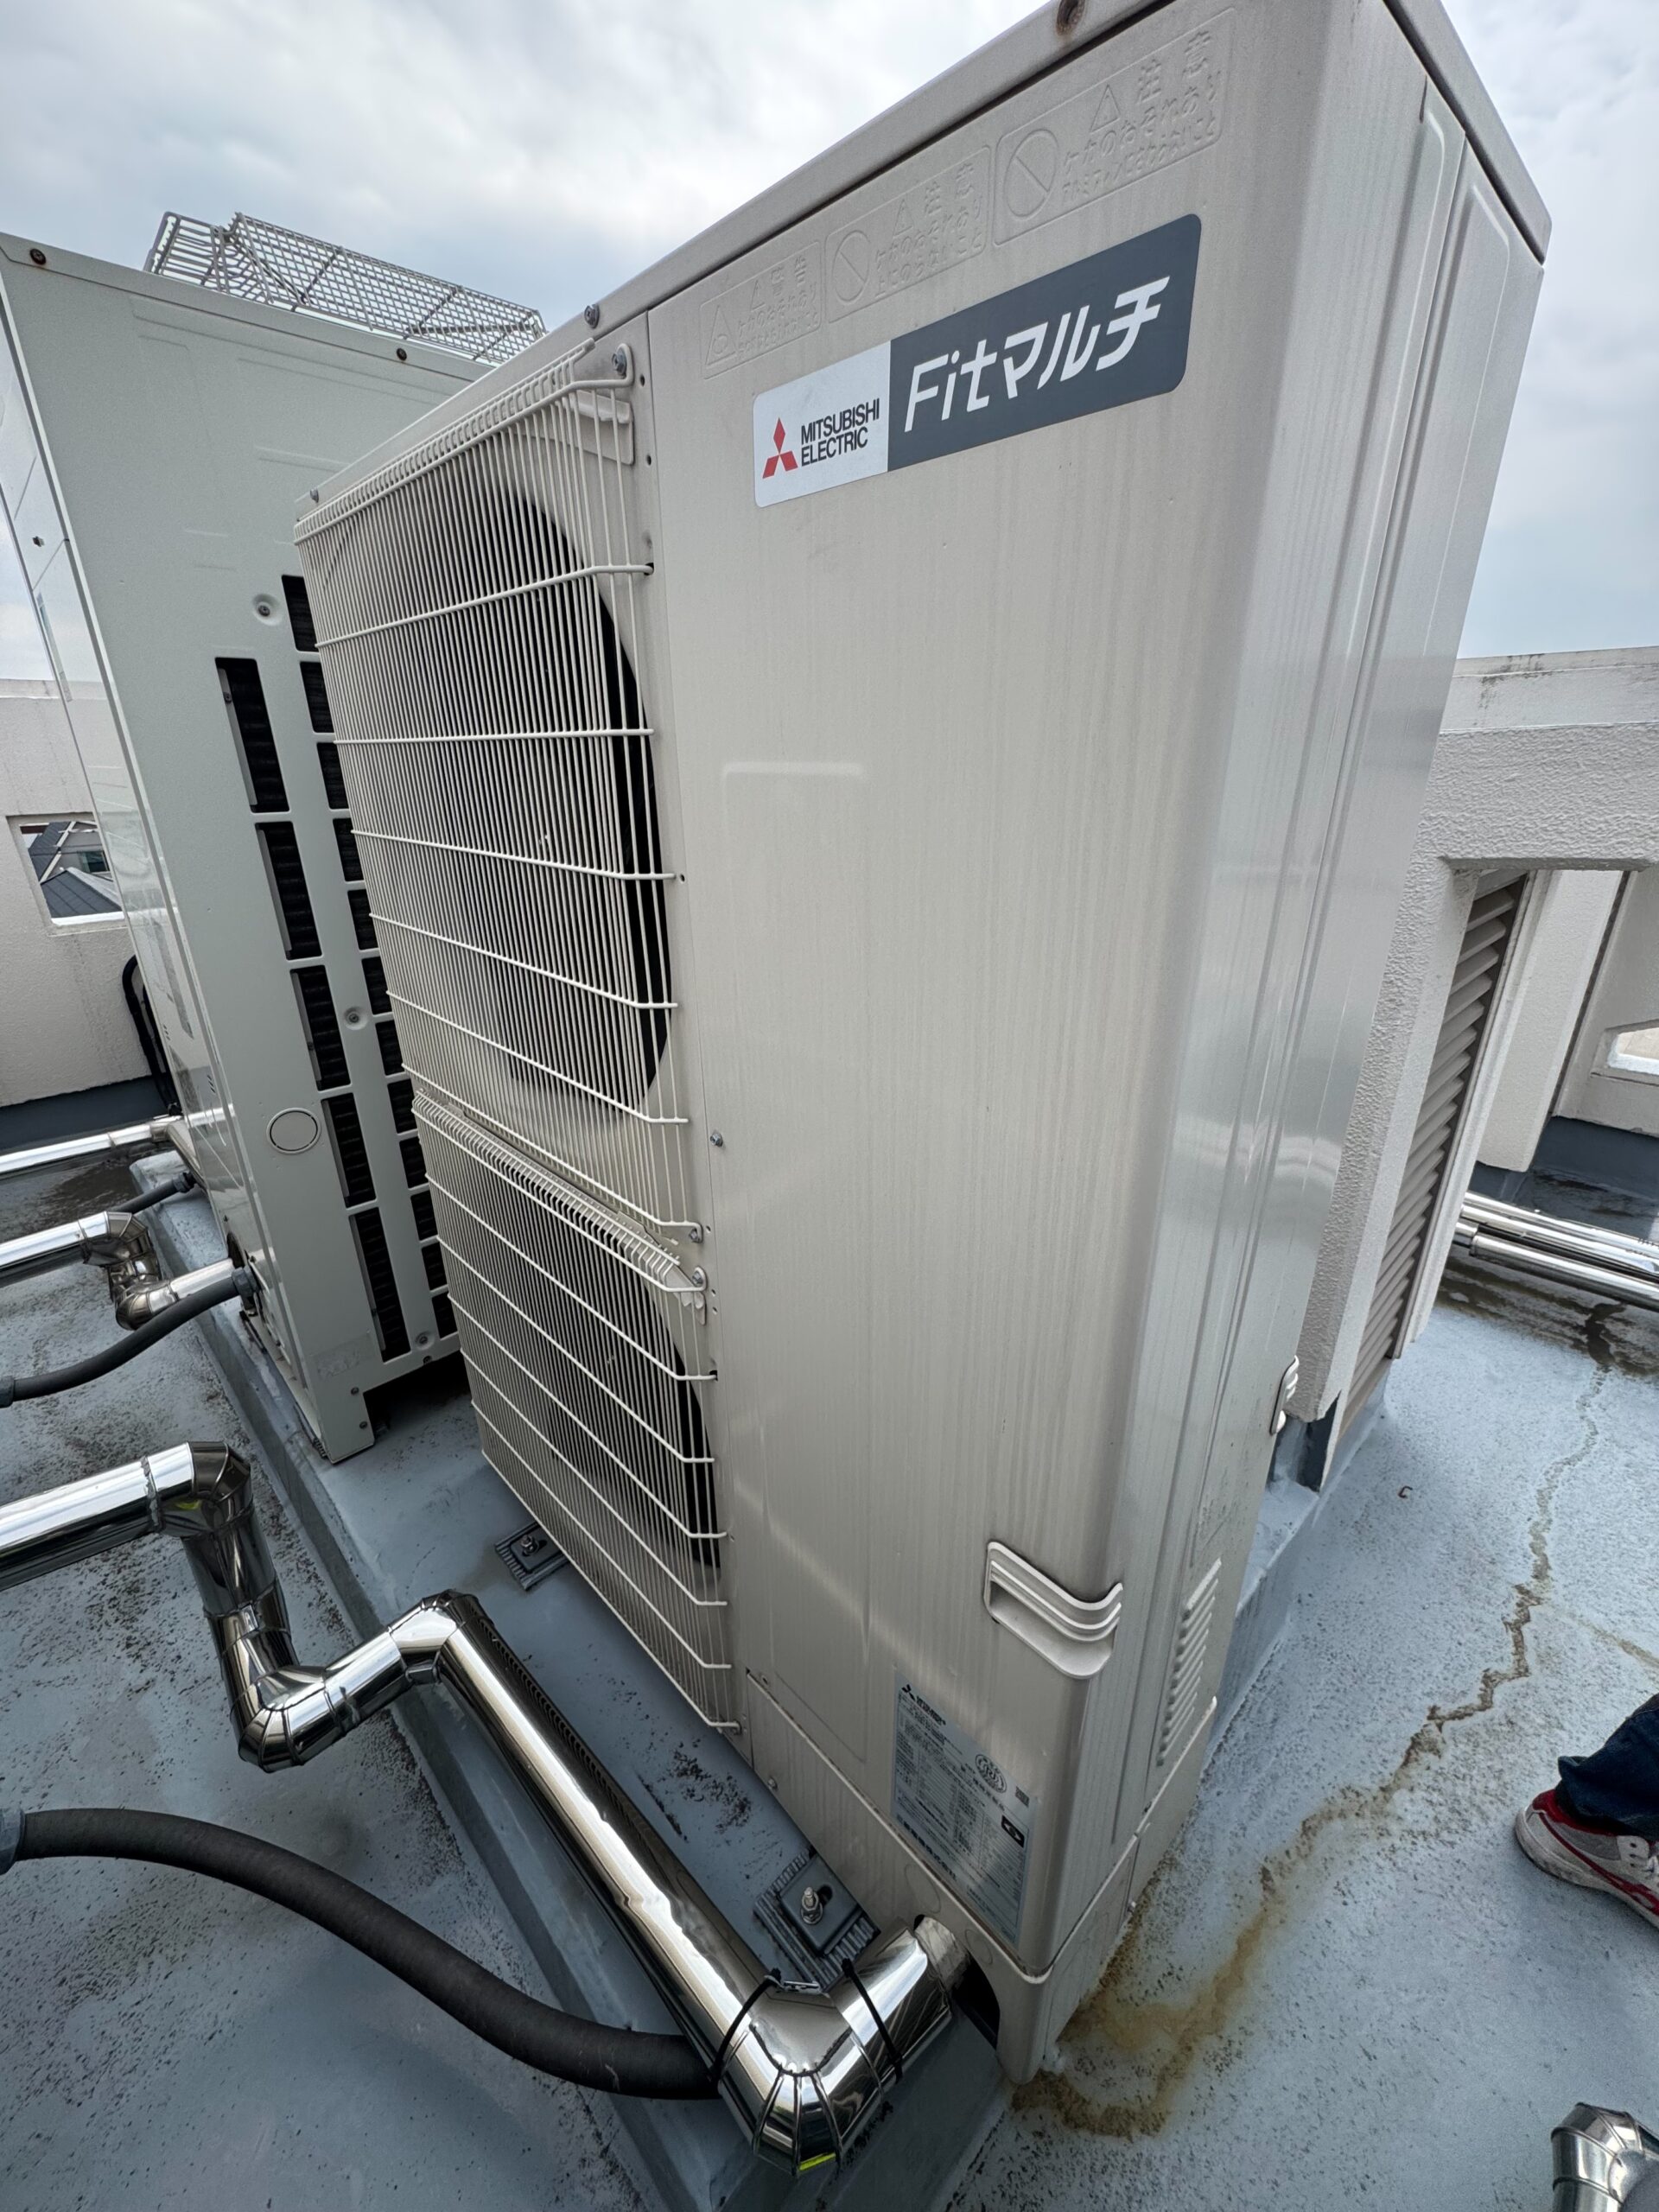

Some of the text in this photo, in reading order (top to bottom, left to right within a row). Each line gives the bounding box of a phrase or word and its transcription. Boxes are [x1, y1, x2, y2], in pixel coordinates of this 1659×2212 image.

[905, 276, 1170, 432] Fitマルチ
[801, 397, 880, 446] MITSUBISHI
[801, 426, 868, 467] ELECTRIC
